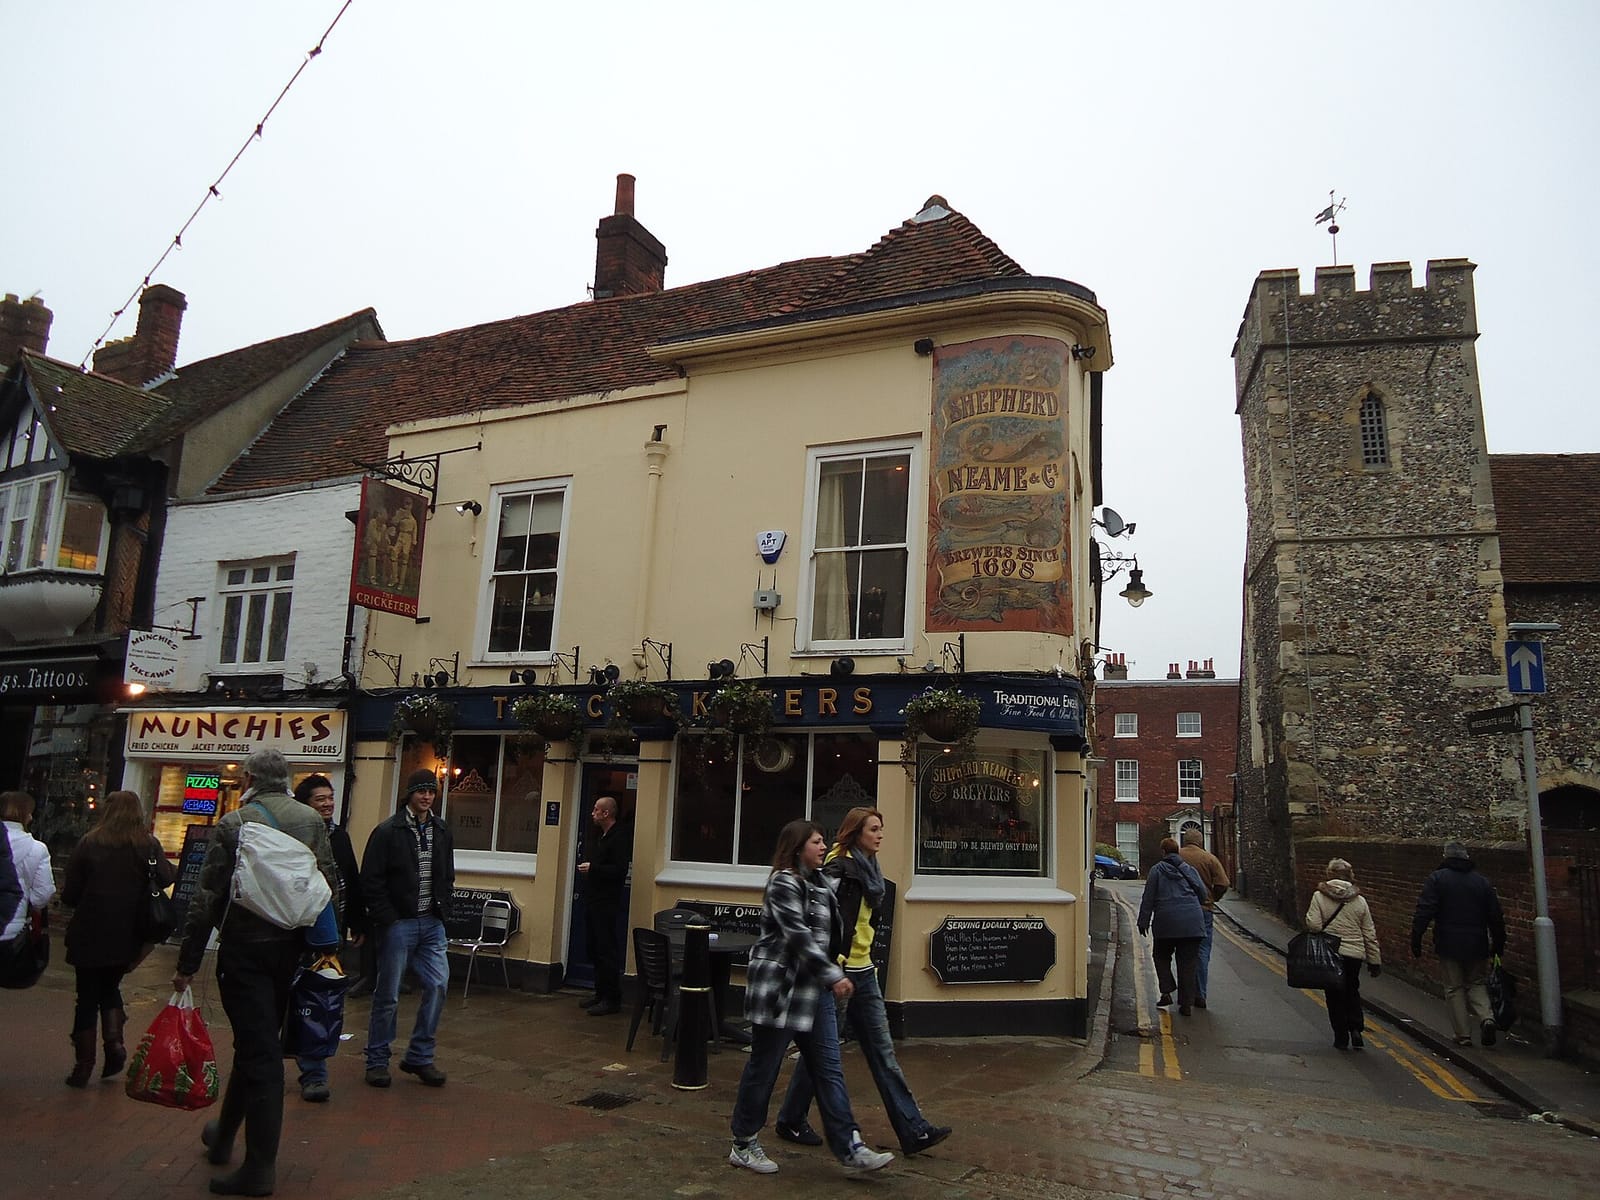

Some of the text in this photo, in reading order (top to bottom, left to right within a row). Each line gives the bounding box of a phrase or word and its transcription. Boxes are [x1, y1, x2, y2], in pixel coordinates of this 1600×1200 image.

[951, 388, 1059, 423] SHEPHERD
[947, 464, 1028, 493] NEAME
[761, 538, 777, 547] APT
[944, 546, 1059, 567] BREWERS SINCE
[972, 558, 1035, 580] 1698
[356, 592, 417, 615] CRICKETERS
[131, 634, 178, 651] MUNCHIES
[129, 661, 175, 678] TAKEAWAY
[993, 690, 1061, 707] TRADITIONAL
[1000, 704, 1021, 716] Fine
[1025, 705, 1046, 718] Food
[139, 712, 330, 742] MUNCHIES
[131, 742, 337, 753] FRIED CHICKEN JACKET POTATOES BURGERS
[186, 776, 219, 789] PIZZAS
[953, 783, 1010, 802] BREWERS
[183, 799, 216, 811] KEBABS
[960, 841, 968, 850] TO
[980, 842, 1004, 851] BREWED
[1005, 842, 1020, 851] ONLY
[451, 889, 492, 900] RCED FOOD
[714, 906, 762, 918] WE ONLY
[946, 921, 1043, 931] SERVING LOCALLY SOURCED
